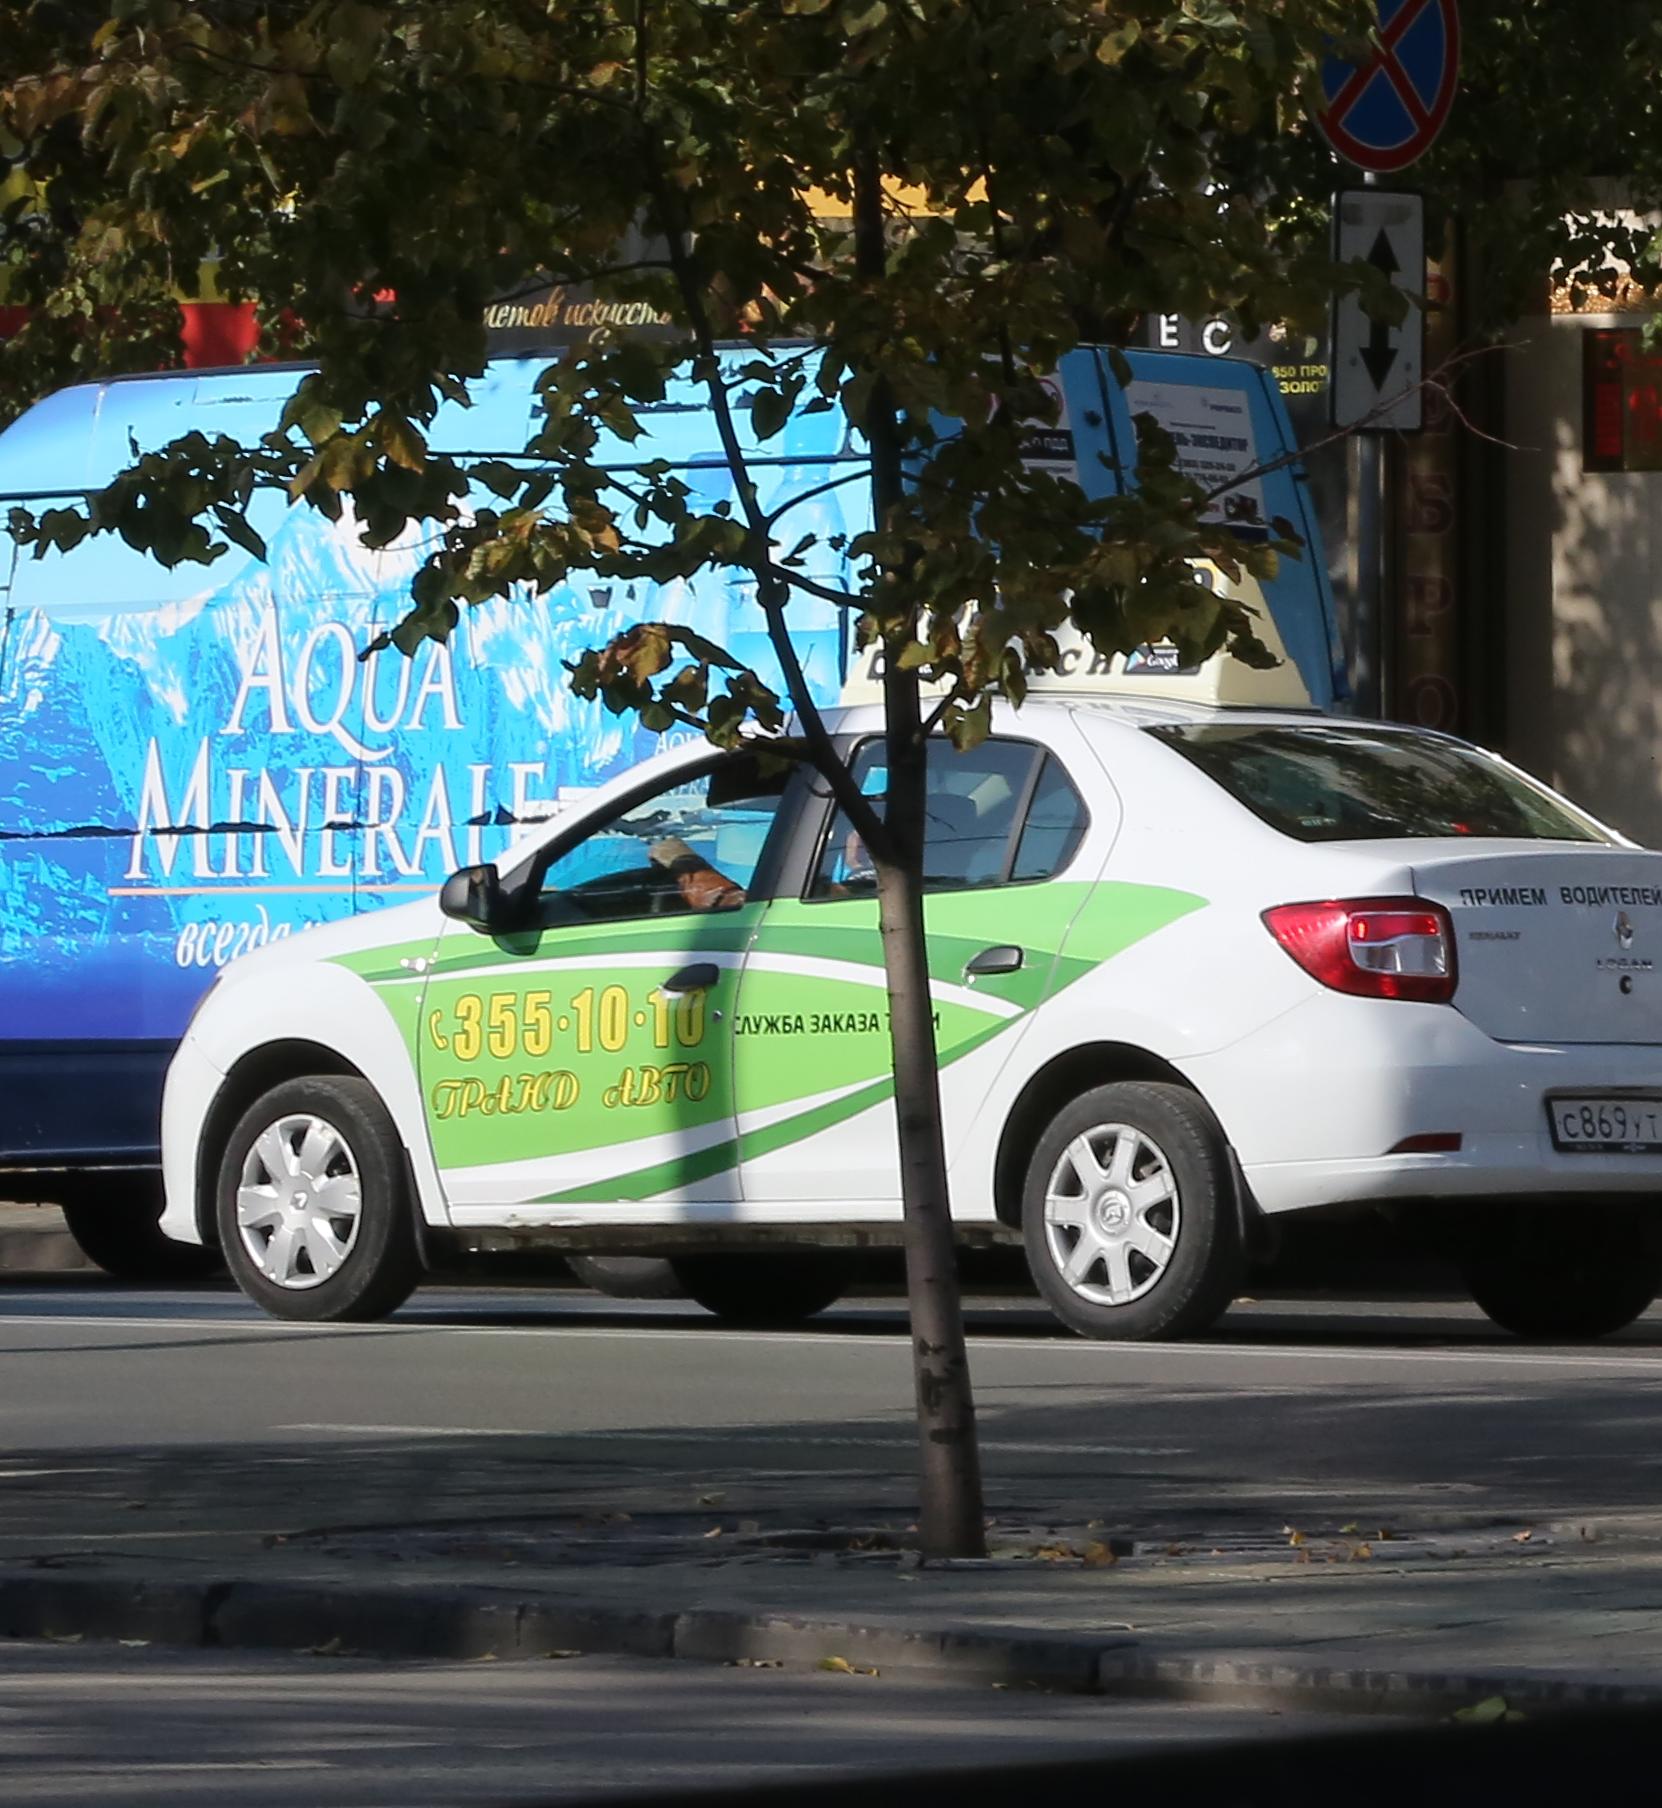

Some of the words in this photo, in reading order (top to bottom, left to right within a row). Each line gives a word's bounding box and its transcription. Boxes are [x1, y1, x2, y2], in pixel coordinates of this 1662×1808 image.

[1280, 381, 1322, 394] ЗОЛО
[218, 596, 464, 763] AQUA
[123, 735, 548, 881] MINERALE
[1460, 888, 1548, 907] ПРИМЕМ
[1596, 958, 1653, 971] LOGAN
[733, 1015, 805, 1036] СЛУЖБА
[809, 1013, 880, 1034] ЗАКАЗА
[602, 1061, 711, 1109] АВТО
[1562, 1105, 1657, 1139] С869УТ
